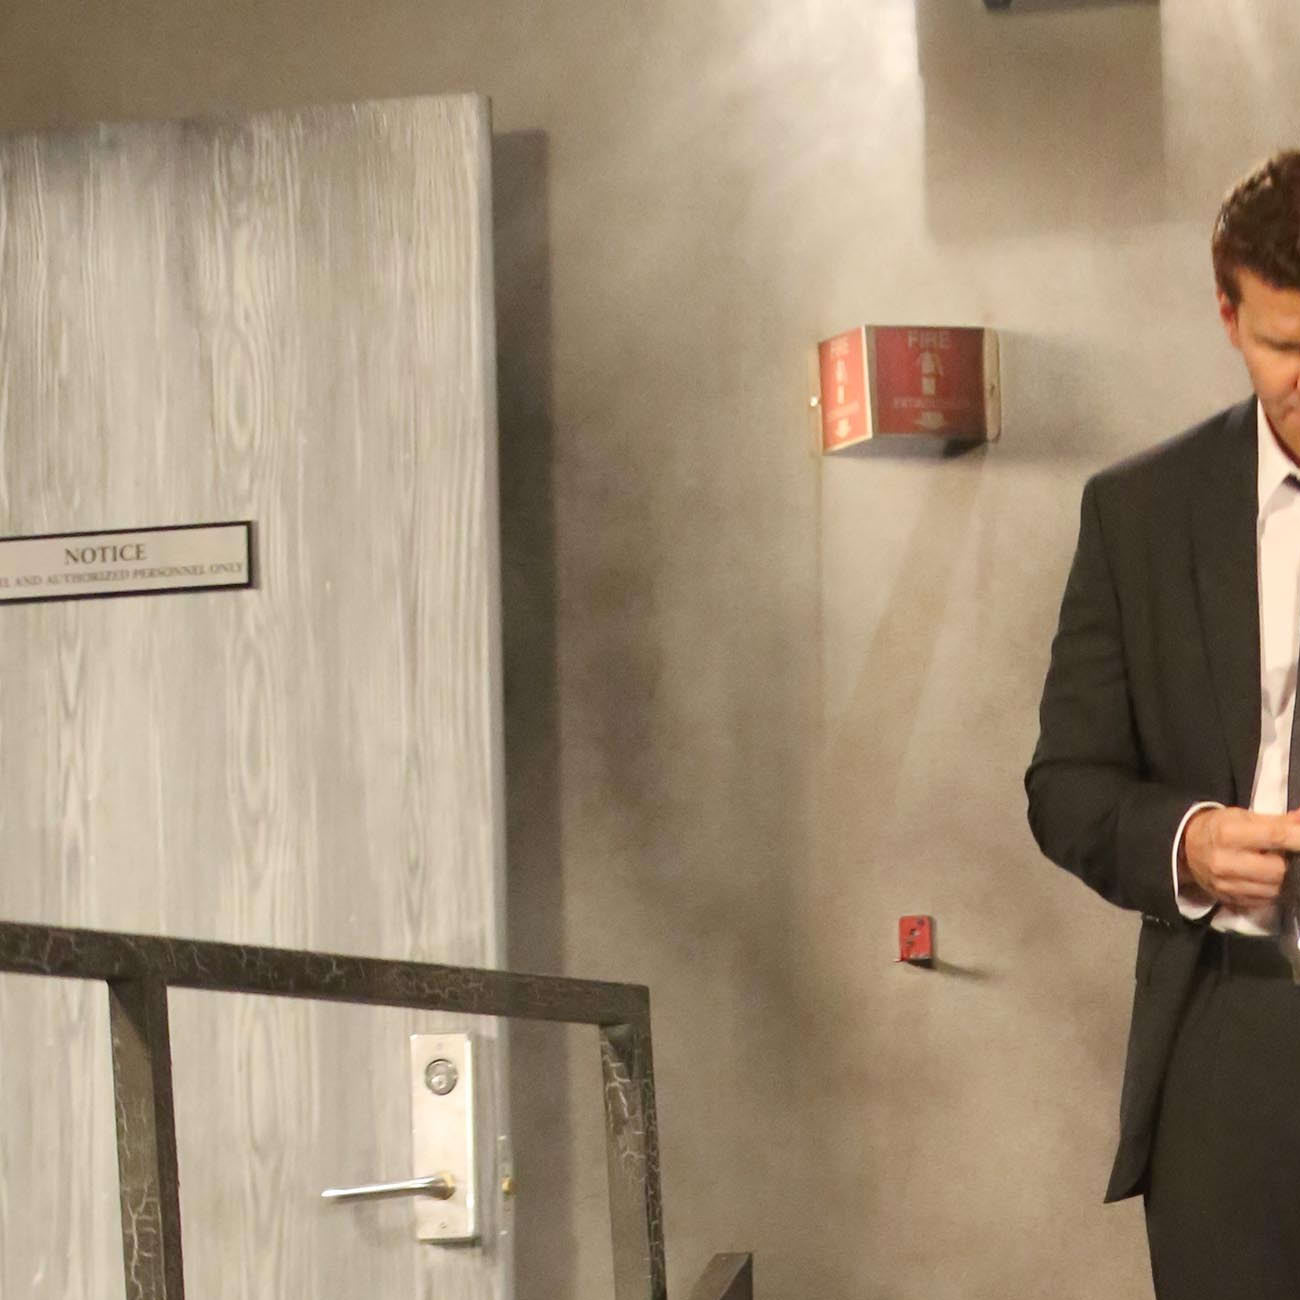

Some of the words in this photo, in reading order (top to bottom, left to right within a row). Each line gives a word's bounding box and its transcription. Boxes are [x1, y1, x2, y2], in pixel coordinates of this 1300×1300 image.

[907, 330, 951, 349] FIRE
[64, 544, 146, 565] NOTICE
[132, 564, 205, 579] PERSONNEL
[209, 561, 243, 574] ONLY
